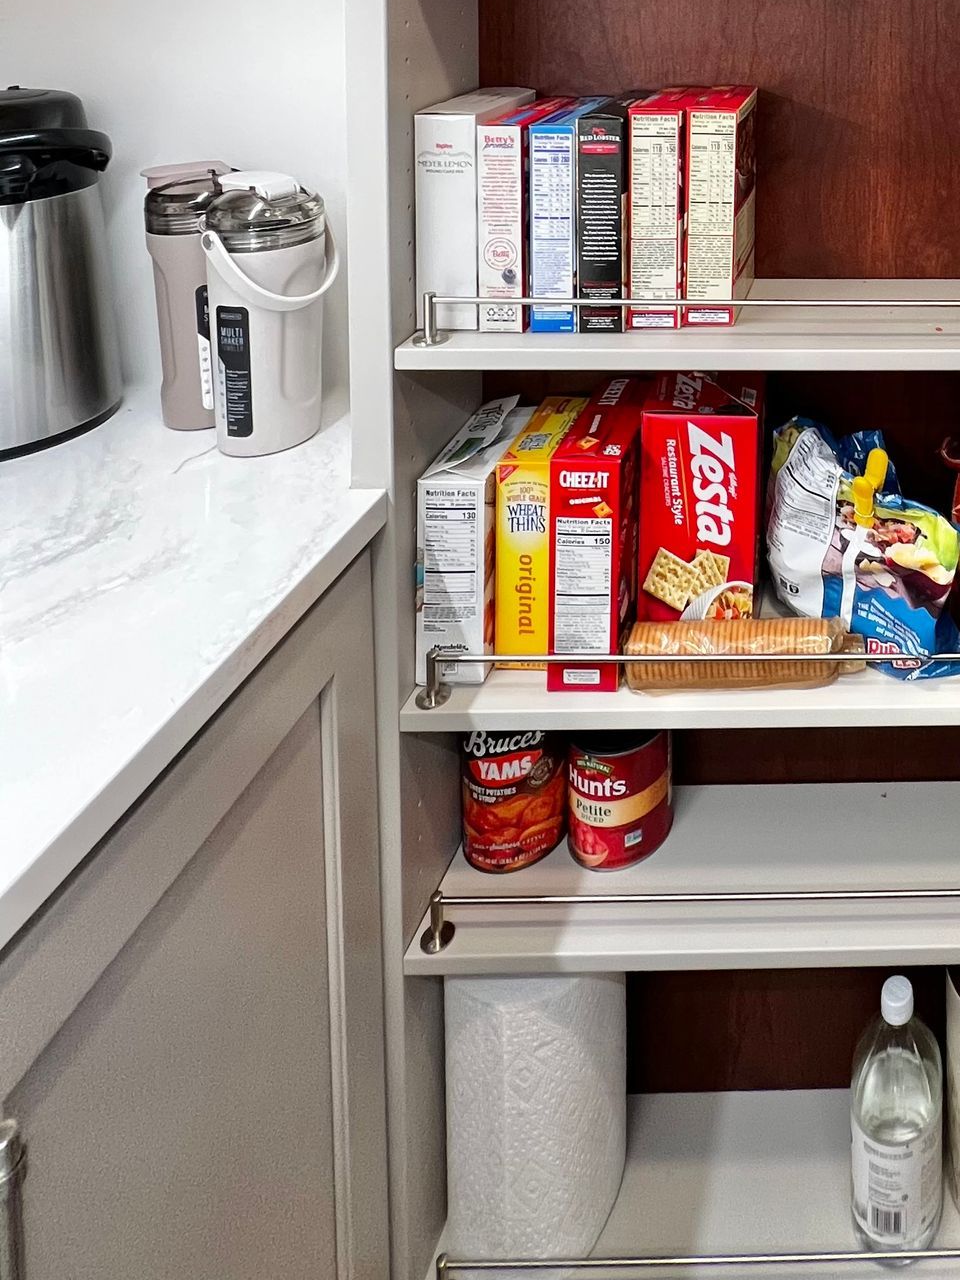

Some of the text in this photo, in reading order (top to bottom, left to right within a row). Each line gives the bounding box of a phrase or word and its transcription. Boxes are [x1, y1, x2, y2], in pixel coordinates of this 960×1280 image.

[444, 160, 473, 168] LEMON
[220, 326, 243, 337] MULTI
[559, 470, 610, 488] CHEEZ-IT
[665, 438, 684, 525] Restaurant Style
[687, 420, 735, 547] Zesta
[462, 511, 476, 519] 130
[506, 503, 547, 517] WHEAT
[508, 516, 547, 533] THINS
[593, 537, 611, 545] 150
[514, 553, 537, 636] original
[477, 756, 533, 781] YAMS
[478, 793, 497, 804] SYRUP
[486, 786, 517, 796] POTATOES
[576, 798, 612, 817] Petite
